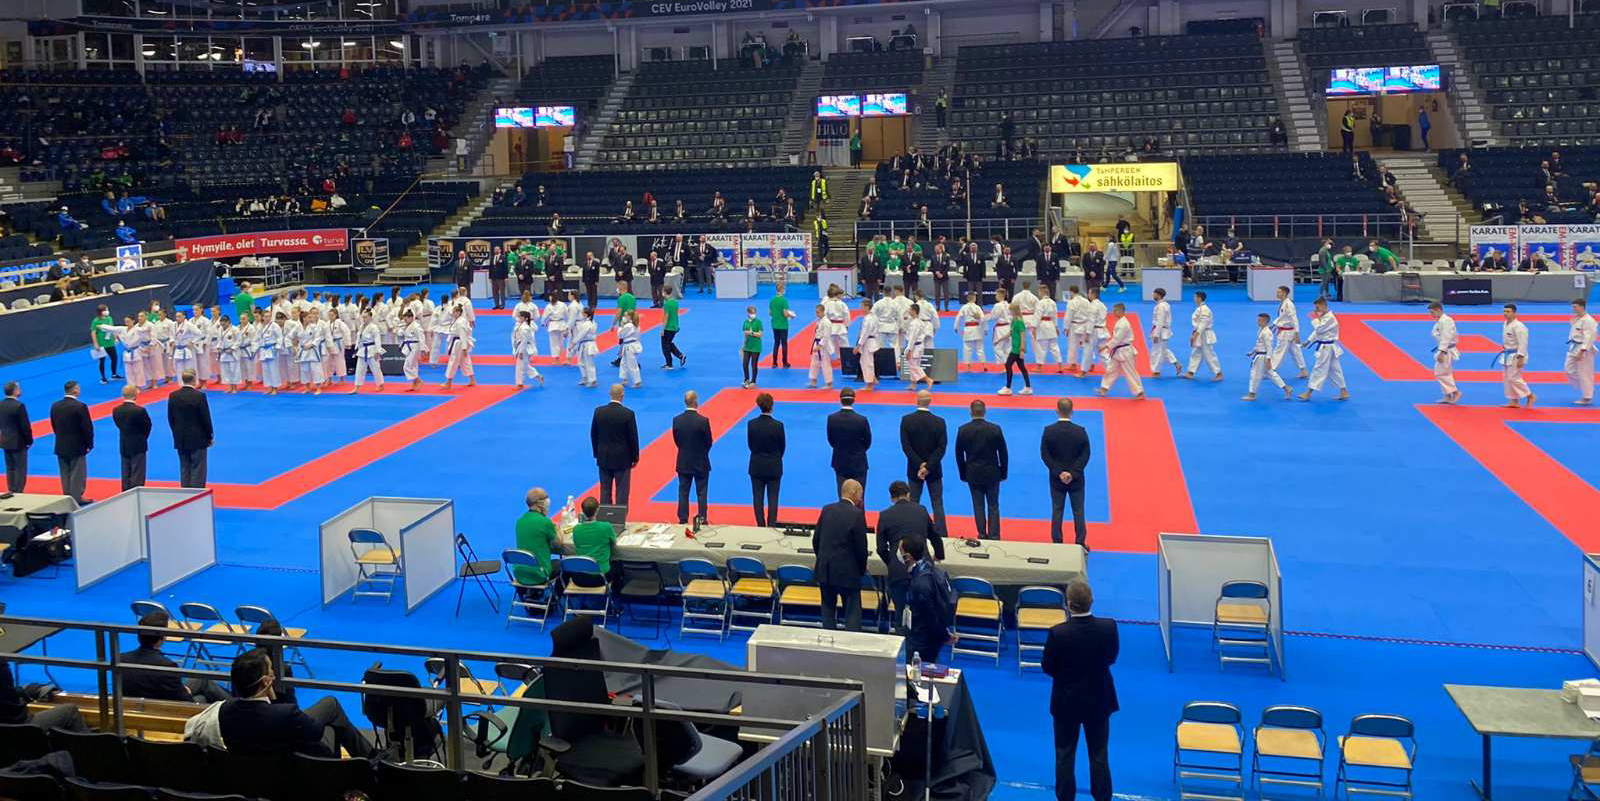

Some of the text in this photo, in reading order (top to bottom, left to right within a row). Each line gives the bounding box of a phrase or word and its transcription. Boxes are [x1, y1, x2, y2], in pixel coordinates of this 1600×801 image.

[651, 0, 753, 13] CEV EuroVolley 2021
[1097, 176, 1163, 187] sähkölaitos
[1471, 227, 1507, 235] KARATE
[1521, 226, 1558, 234] KARATE
[192, 238, 308, 254] Hymyile, olet Turvassa.
